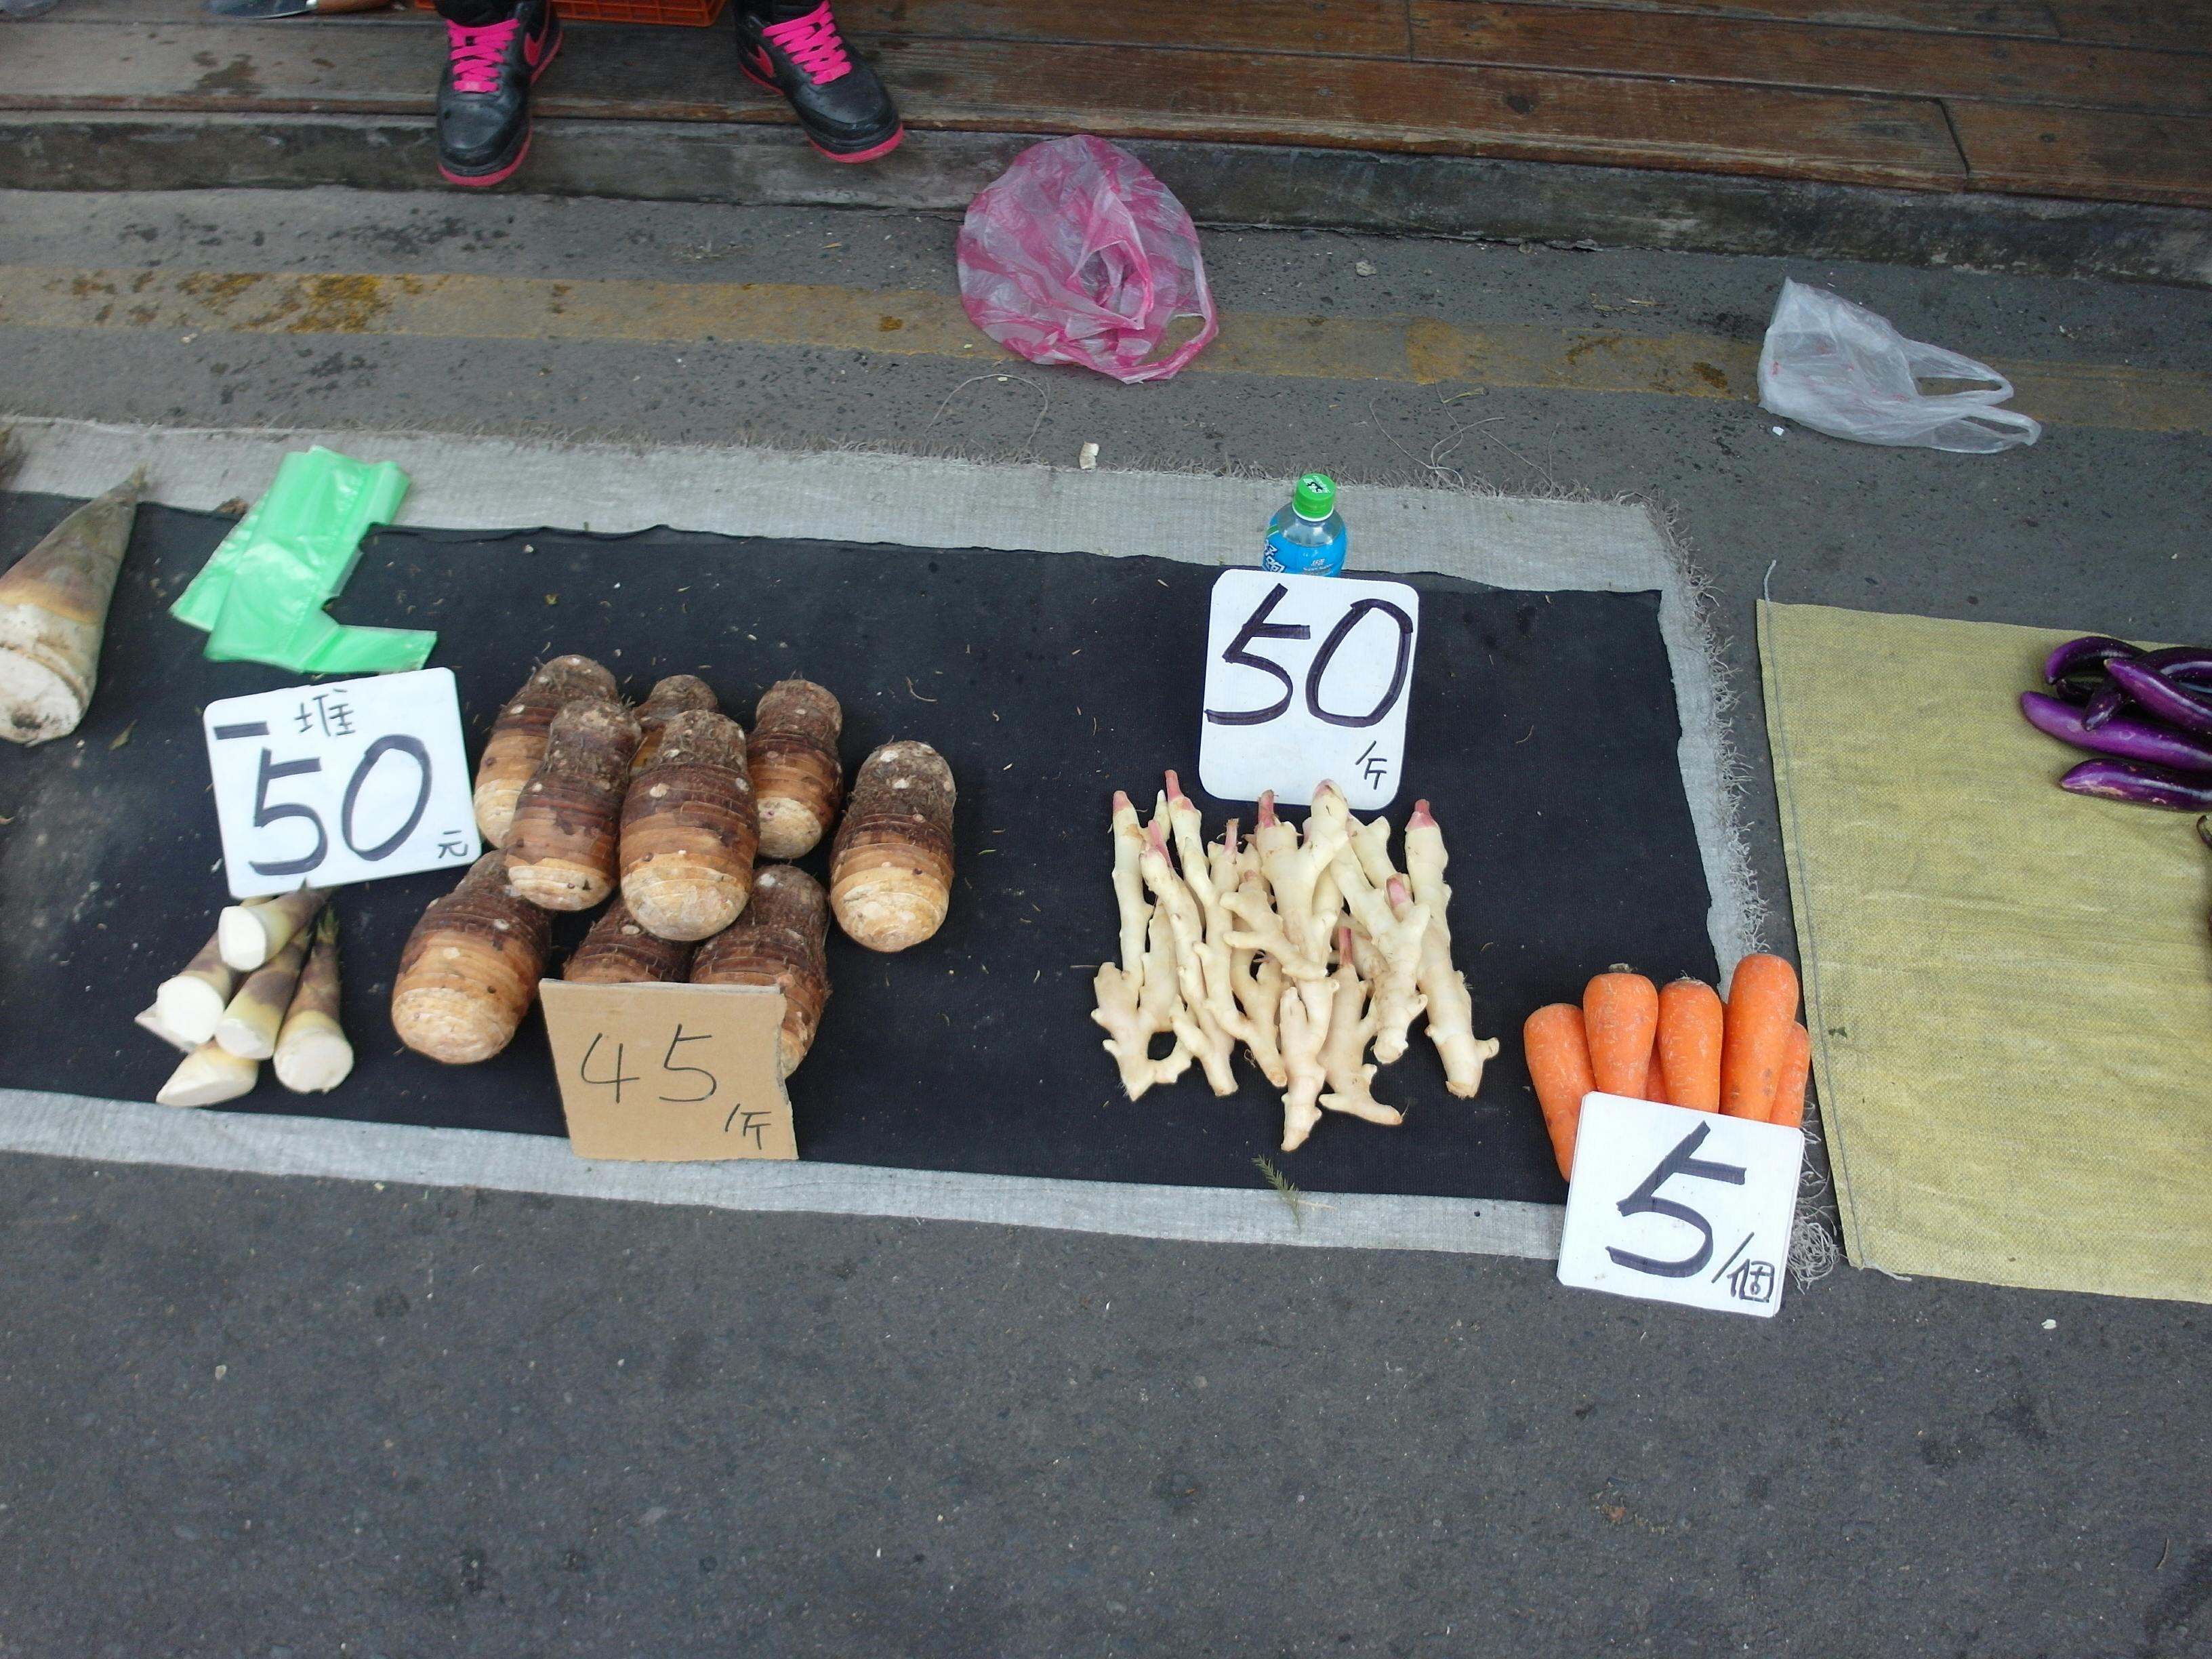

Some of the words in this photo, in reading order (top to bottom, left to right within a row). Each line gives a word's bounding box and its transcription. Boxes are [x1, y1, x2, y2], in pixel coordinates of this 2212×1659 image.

[1204, 583, 1414, 728] 50
[248, 733, 433, 876] 50
[580, 1023, 718, 1104] 45
[1605, 1120, 1747, 1278] 5
